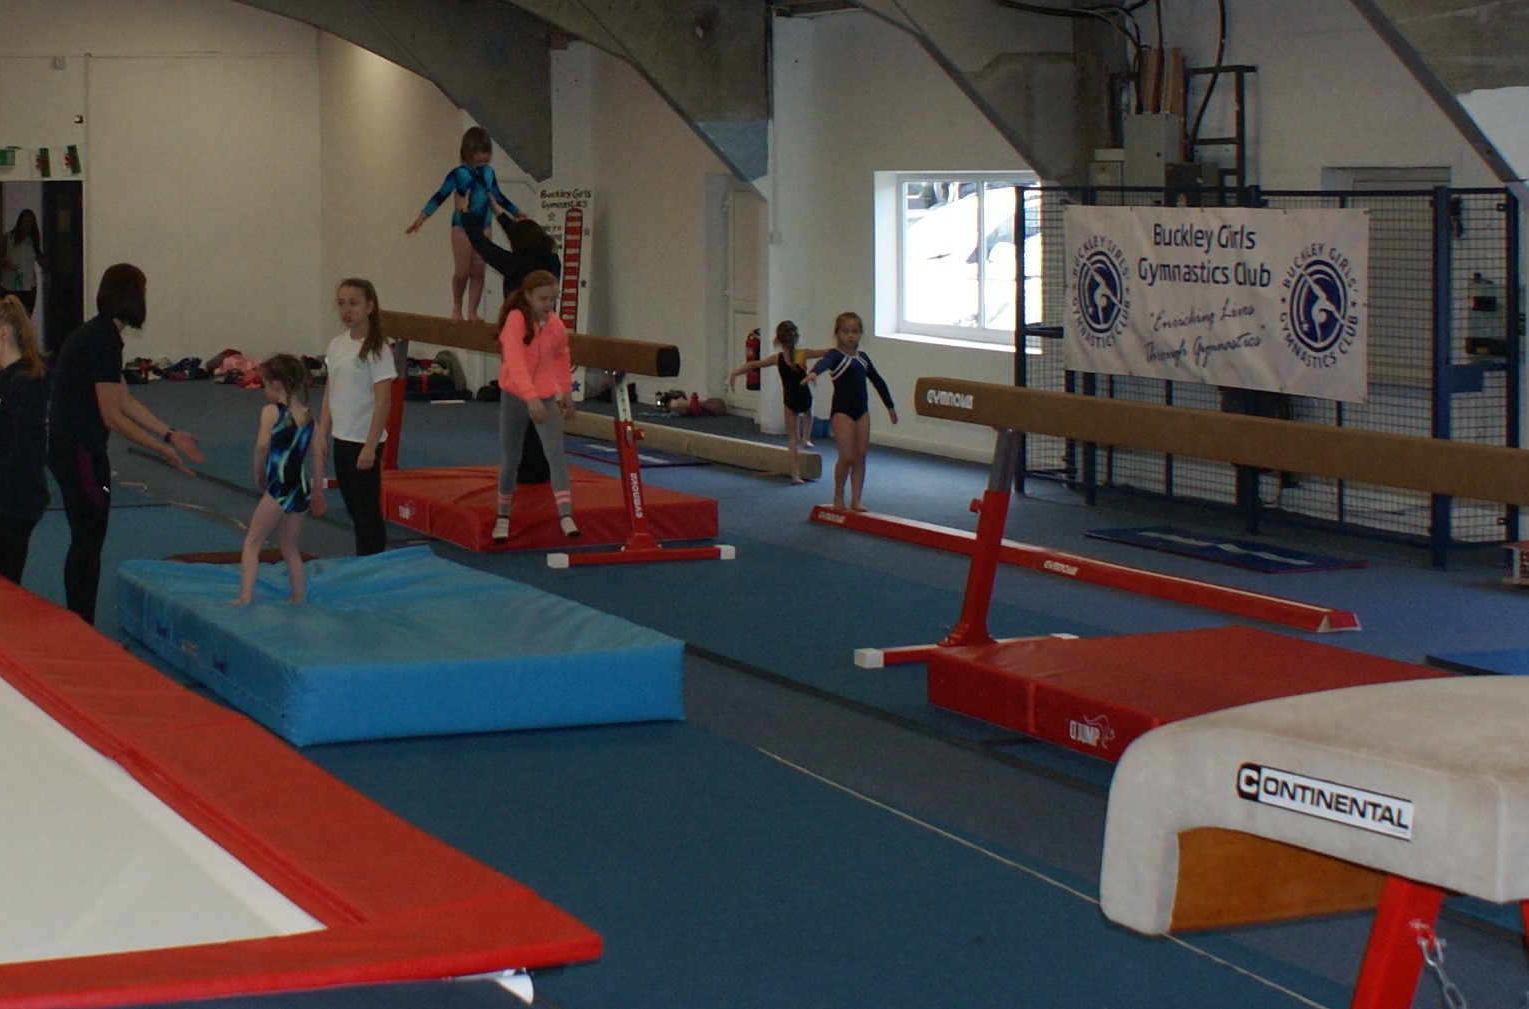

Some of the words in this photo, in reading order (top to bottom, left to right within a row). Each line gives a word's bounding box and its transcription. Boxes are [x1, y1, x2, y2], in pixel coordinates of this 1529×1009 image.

[572, 188, 591, 198] Girls
[1153, 222, 1213, 254] Buckley
[1217, 224, 1256, 250] Girls
[1138, 257, 1229, 287] Gymnastics
[1234, 261, 1271, 288] Club
[1282, 242, 1325, 289] BUCKLEY
[1279, 312, 1337, 369] GYMNASTICS
[1338, 315, 1359, 355] CLUB
[926, 389, 973, 410] GYMNOVA
[1238, 766, 1409, 829] CONTINENTAL
